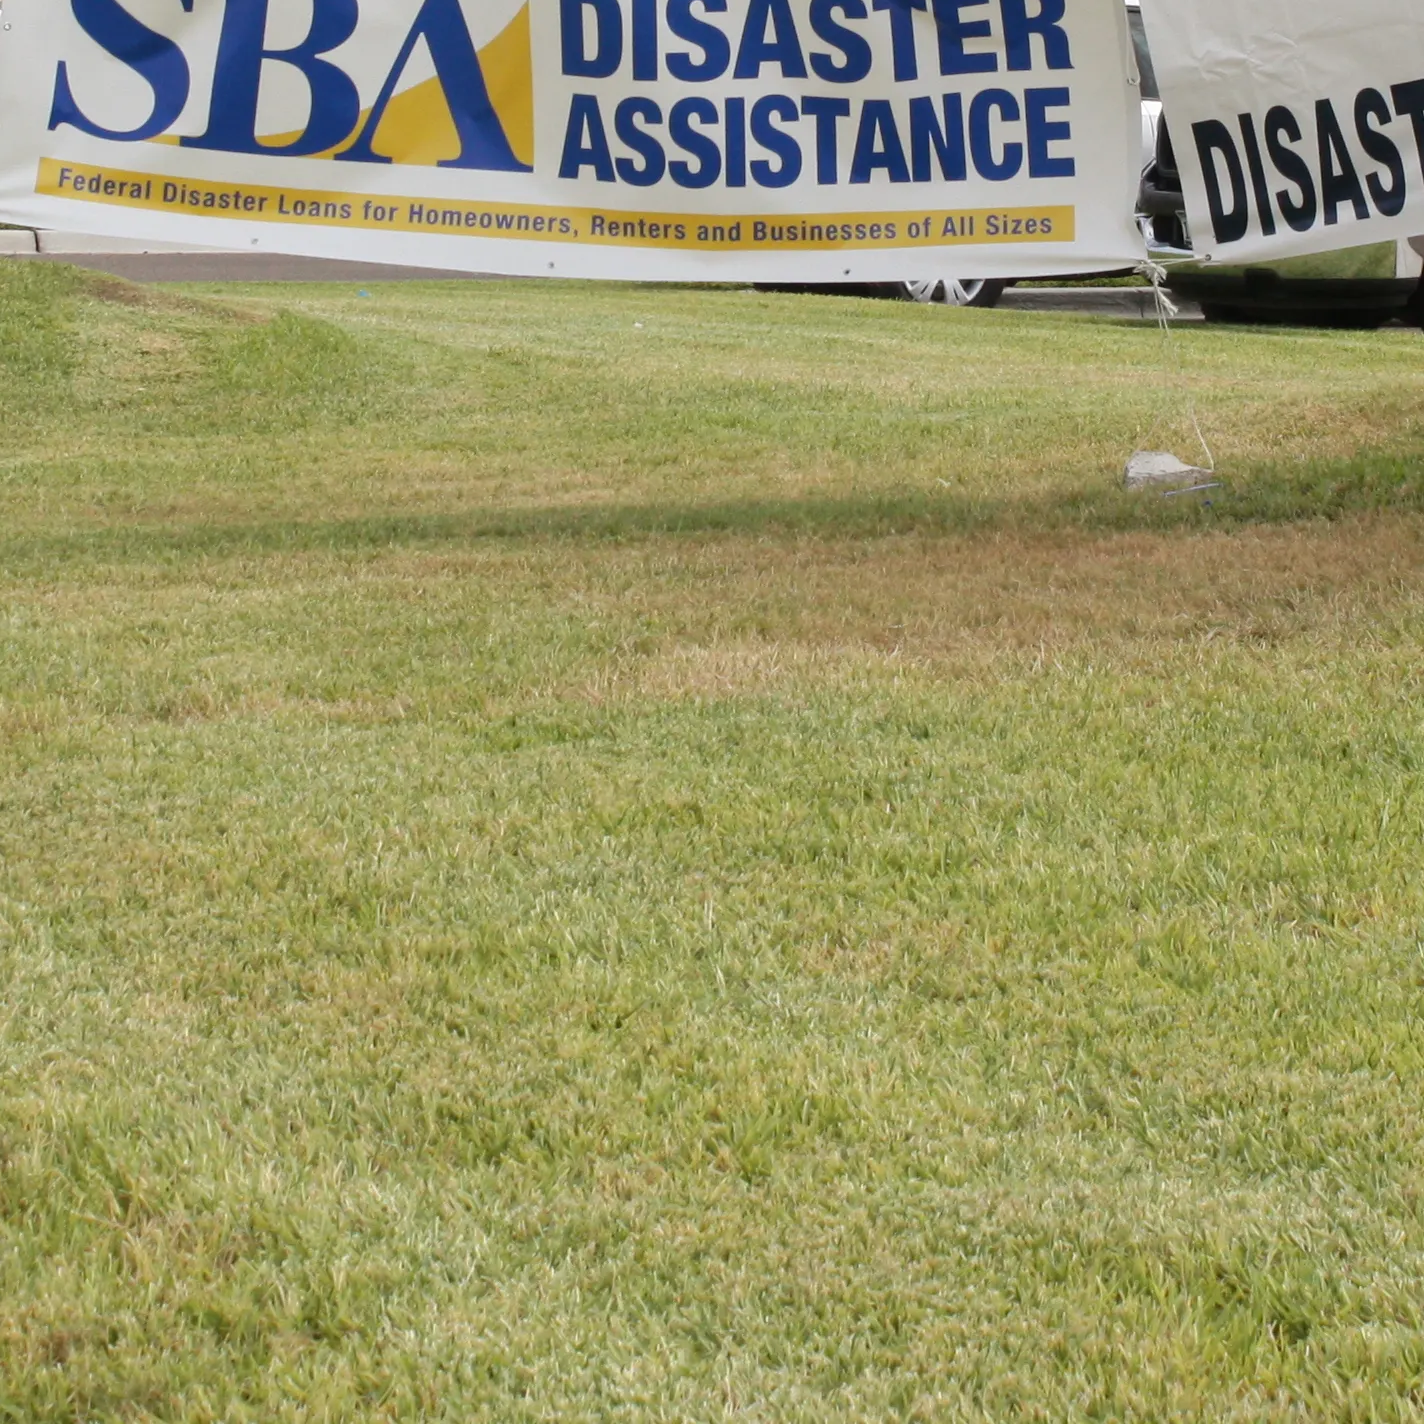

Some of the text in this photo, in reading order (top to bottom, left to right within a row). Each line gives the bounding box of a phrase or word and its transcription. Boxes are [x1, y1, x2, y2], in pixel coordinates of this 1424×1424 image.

[558, 87, 1076, 188] ASSISTANCE
[58, 167, 1052, 243] Federal Disaster Loans for Homeowners, Renters and Businesses of All Sizes
